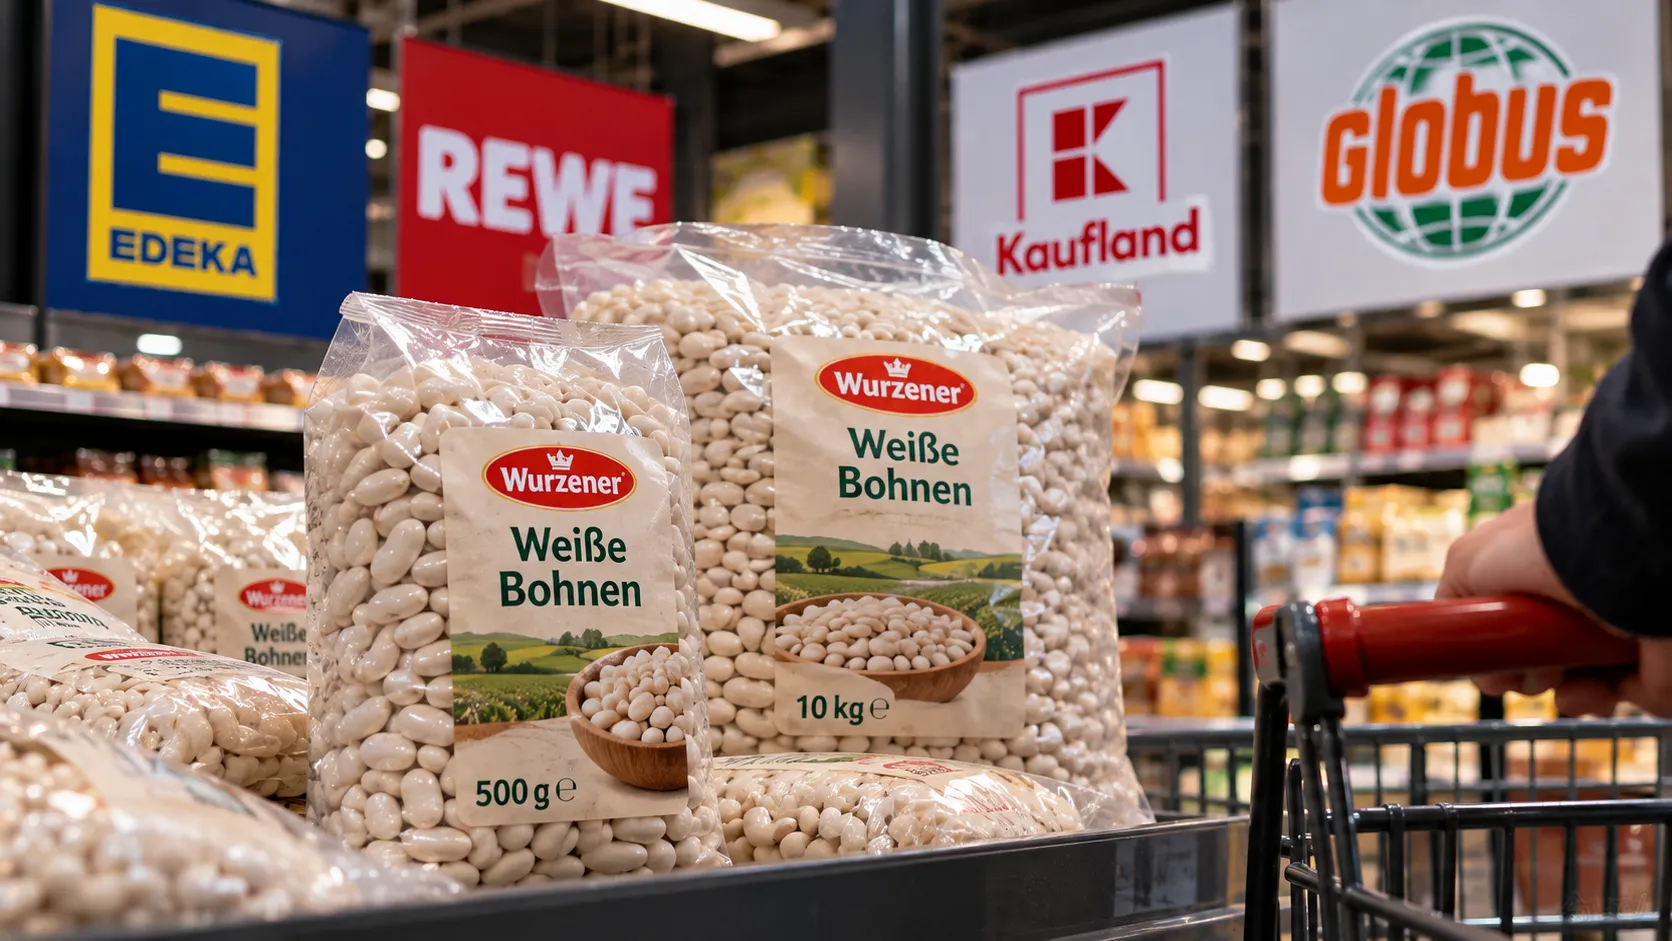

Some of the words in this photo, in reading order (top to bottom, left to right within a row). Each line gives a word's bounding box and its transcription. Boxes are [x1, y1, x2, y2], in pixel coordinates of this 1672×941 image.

[417, 124, 657, 241] REWE
[109, 227, 258, 277] EDEKA
[996, 207, 1200, 276] Kaufland
[847, 427, 960, 466] Weiße
[838, 465, 972, 506] Bohnen
[510, 526, 627, 563] Weiße
[499, 569, 642, 607] Bohnen
[250, 622, 307, 642] Weiße
[796, 694, 827, 719] 10
[834, 694, 864, 726] kg
[475, 778, 528, 807] 500
[533, 783, 550, 811] g
